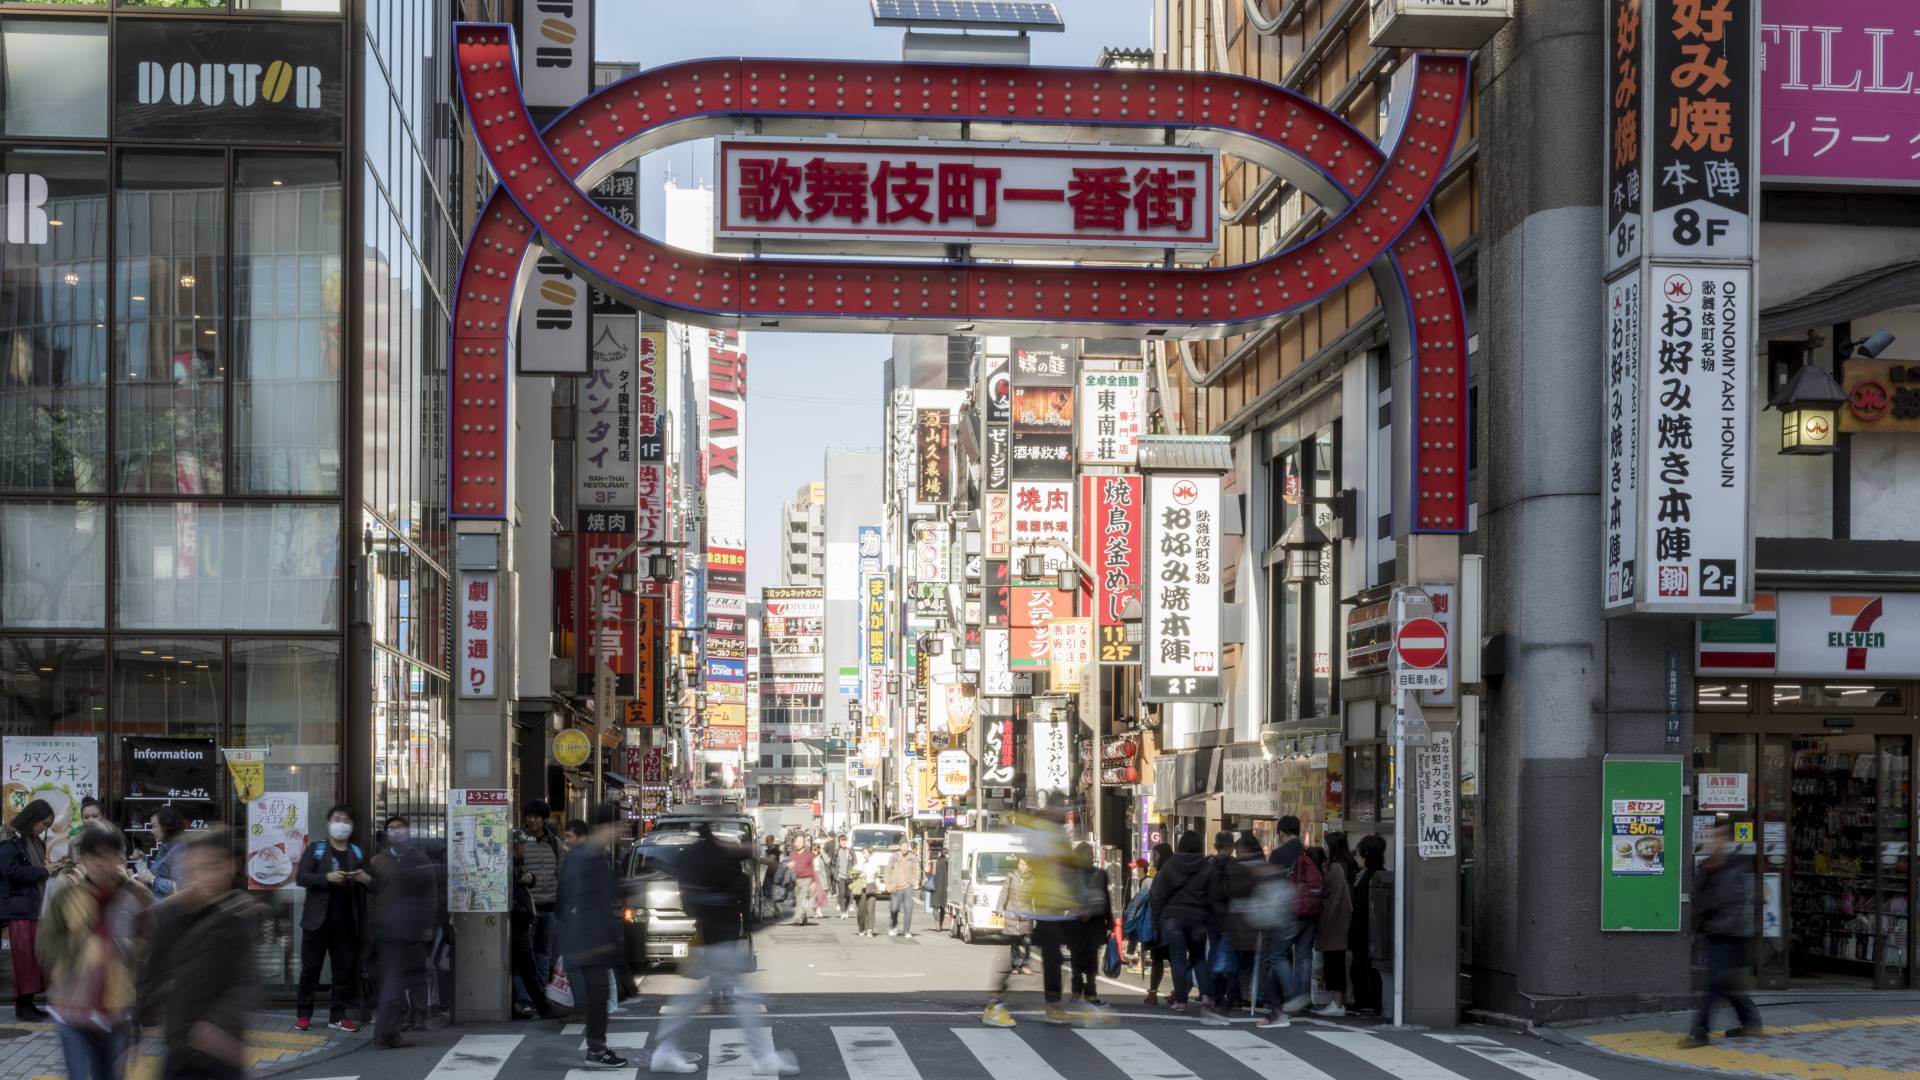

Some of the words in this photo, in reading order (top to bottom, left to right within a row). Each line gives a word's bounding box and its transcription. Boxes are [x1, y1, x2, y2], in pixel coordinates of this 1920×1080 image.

[138, 59, 321, 108] DOUTOR
[1760, 23, 1920, 95] ILL
[1771, 116, 1920, 159] ィラー
[738, 158, 1196, 231] 歌舞伎町一番街
[1613, 167, 1639, 212] 本陣
[1661, 157, 1741, 198] 本陣
[7, 173, 49, 245] R
[1672, 207, 1731, 247] 8F
[1616, 221, 1637, 258] 8F
[1630, 282, 1639, 412] OKONOMIYAKI
[1701, 280, 1717, 373] 歌舞伎町名物
[1720, 281, 1737, 412] OKONOMIYAKI
[1086, 375, 1138, 387] 全卓全自動
[585, 366, 614, 469] バンタイ
[1097, 389, 1117, 460] 東南荘
[1656, 304, 1693, 563] お好み焼き本陣
[641, 444, 661, 457] 1F
[1608, 317, 1623, 568] お好み焼き本陣
[1628, 419, 1636, 489] HONJIN
[1720, 416, 1737, 488] HONJIN
[594, 491, 617, 503] 3F
[1016, 486, 1069, 513] 焼肉
[587, 512, 627, 532] 焼肉
[1104, 477, 1132, 622] 焼鳥釜めし
[1159, 506, 1192, 666] お好み焼本陣
[1622, 569, 1634, 591] 2F
[1702, 564, 1735, 590] 2F
[467, 580, 489, 687] 劇場通り
[1399, 674, 1443, 686] 自転車を除く
[23, 752, 78, 763] カマンベール
[134, 748, 203, 760] information
